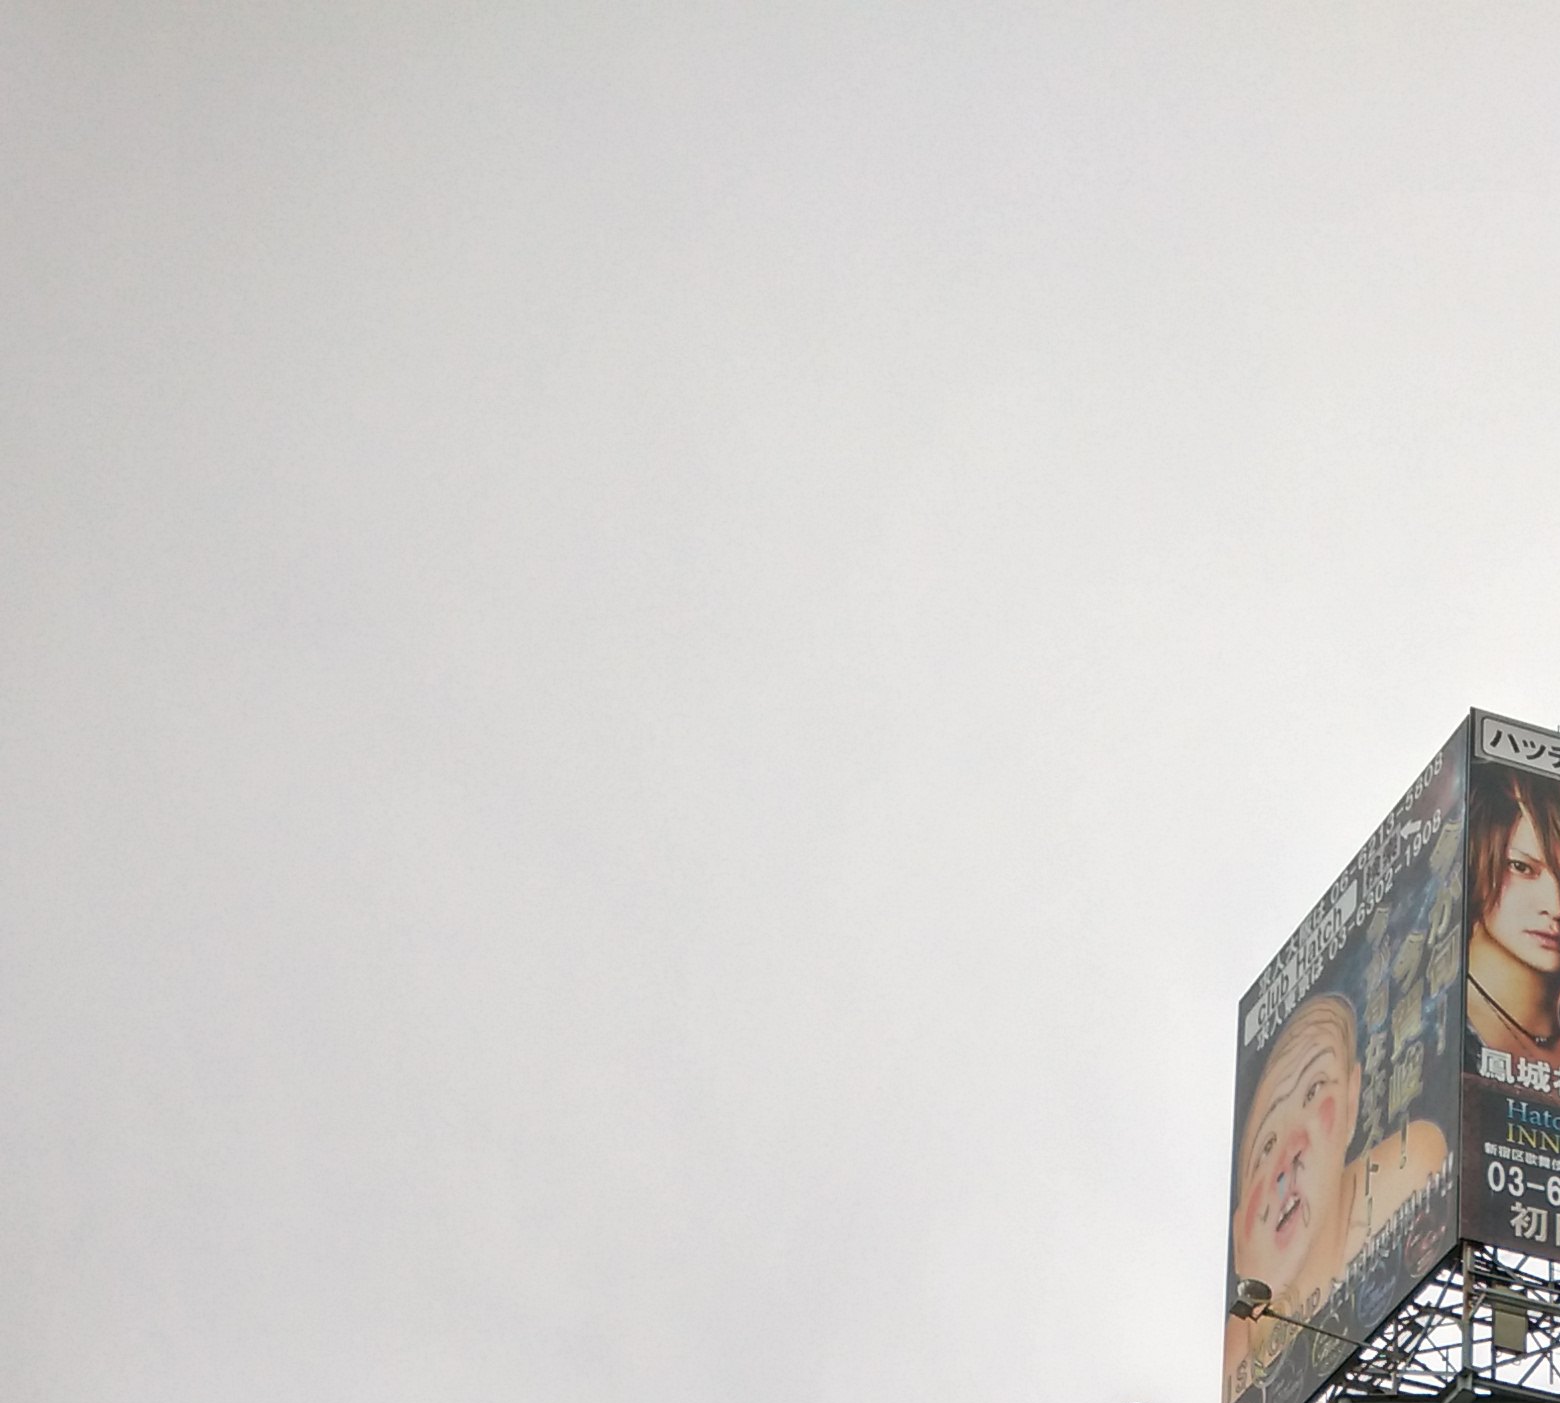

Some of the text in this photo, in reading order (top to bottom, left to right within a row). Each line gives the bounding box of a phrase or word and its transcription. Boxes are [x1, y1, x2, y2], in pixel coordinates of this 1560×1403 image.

[1328, 807, 1443, 963] 03-6302-1908
[1329, 750, 1444, 903] 06-6213-5808
[1256, 904, 1344, 1025] club Hatch
